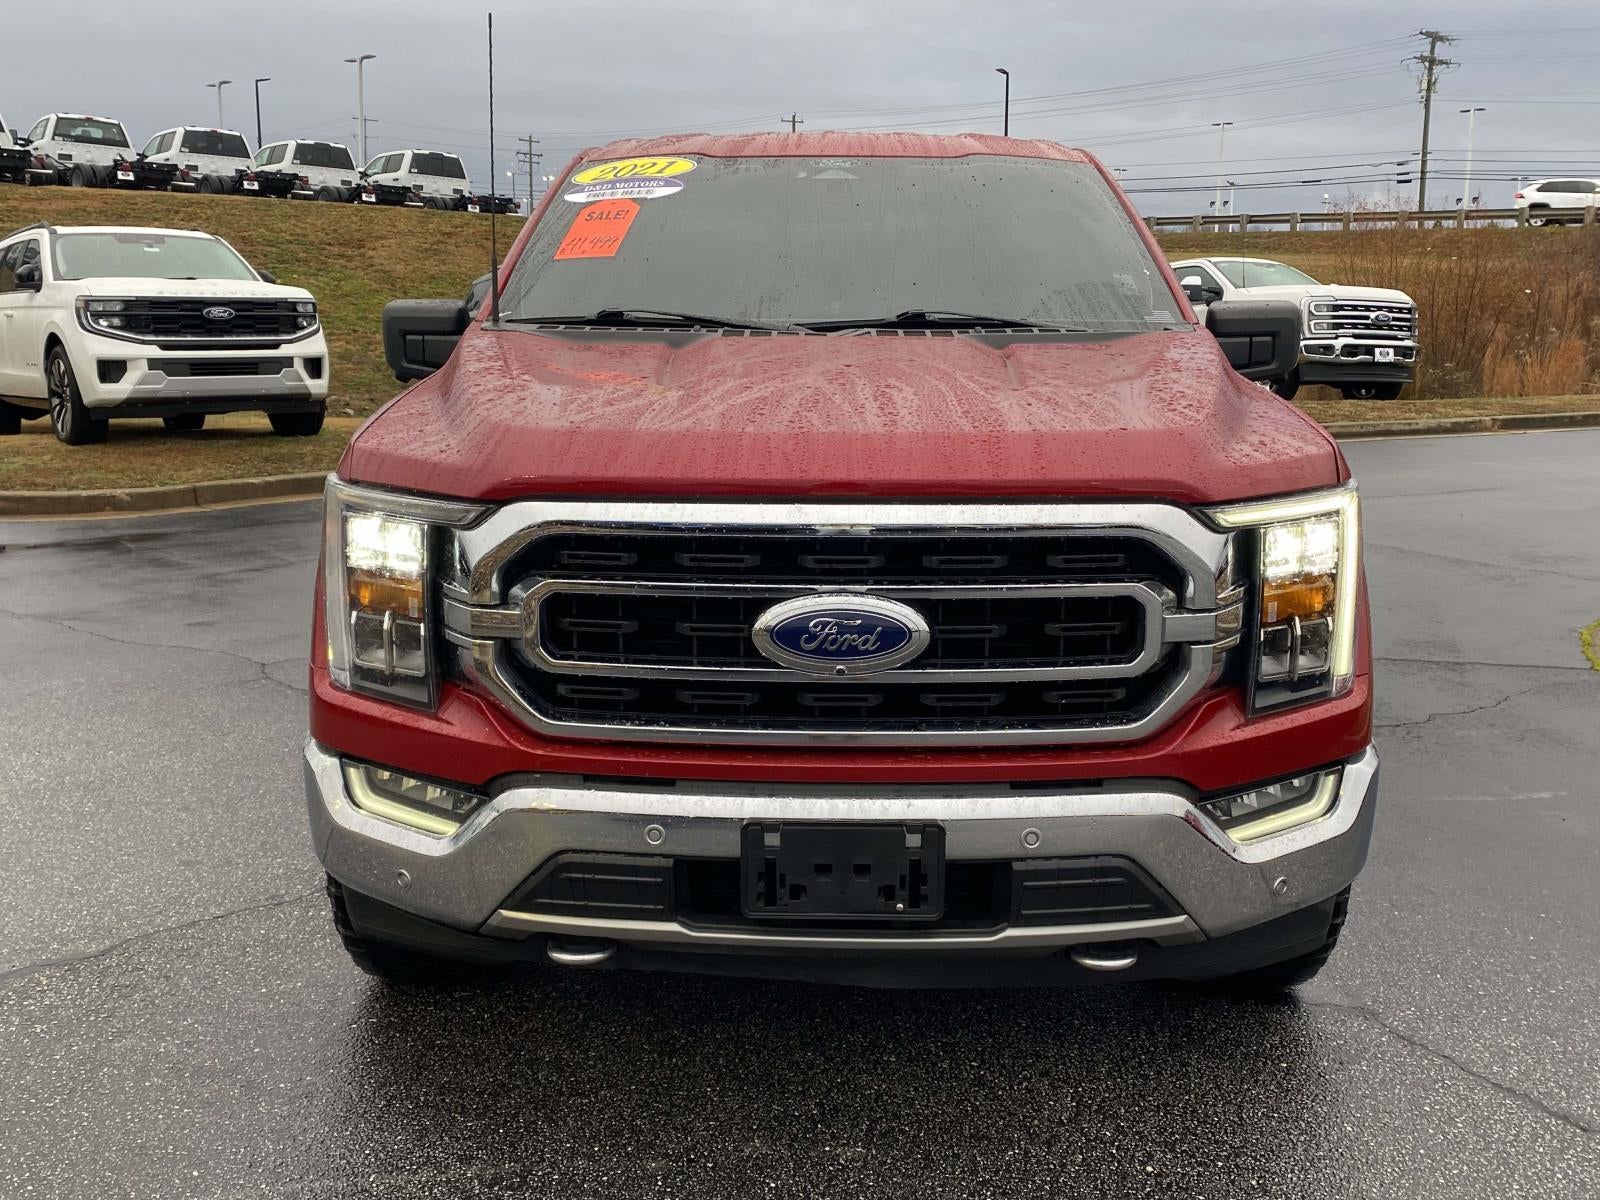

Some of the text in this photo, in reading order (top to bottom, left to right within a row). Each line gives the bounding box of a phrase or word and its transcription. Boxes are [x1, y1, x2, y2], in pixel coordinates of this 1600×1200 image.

[589, 160, 679, 182] 2021
[584, 180, 666, 192] D&D MOTORS
[584, 209, 630, 222] SALE!
[209, 308, 230, 318] Ford
[800, 617, 883, 651] Ford
